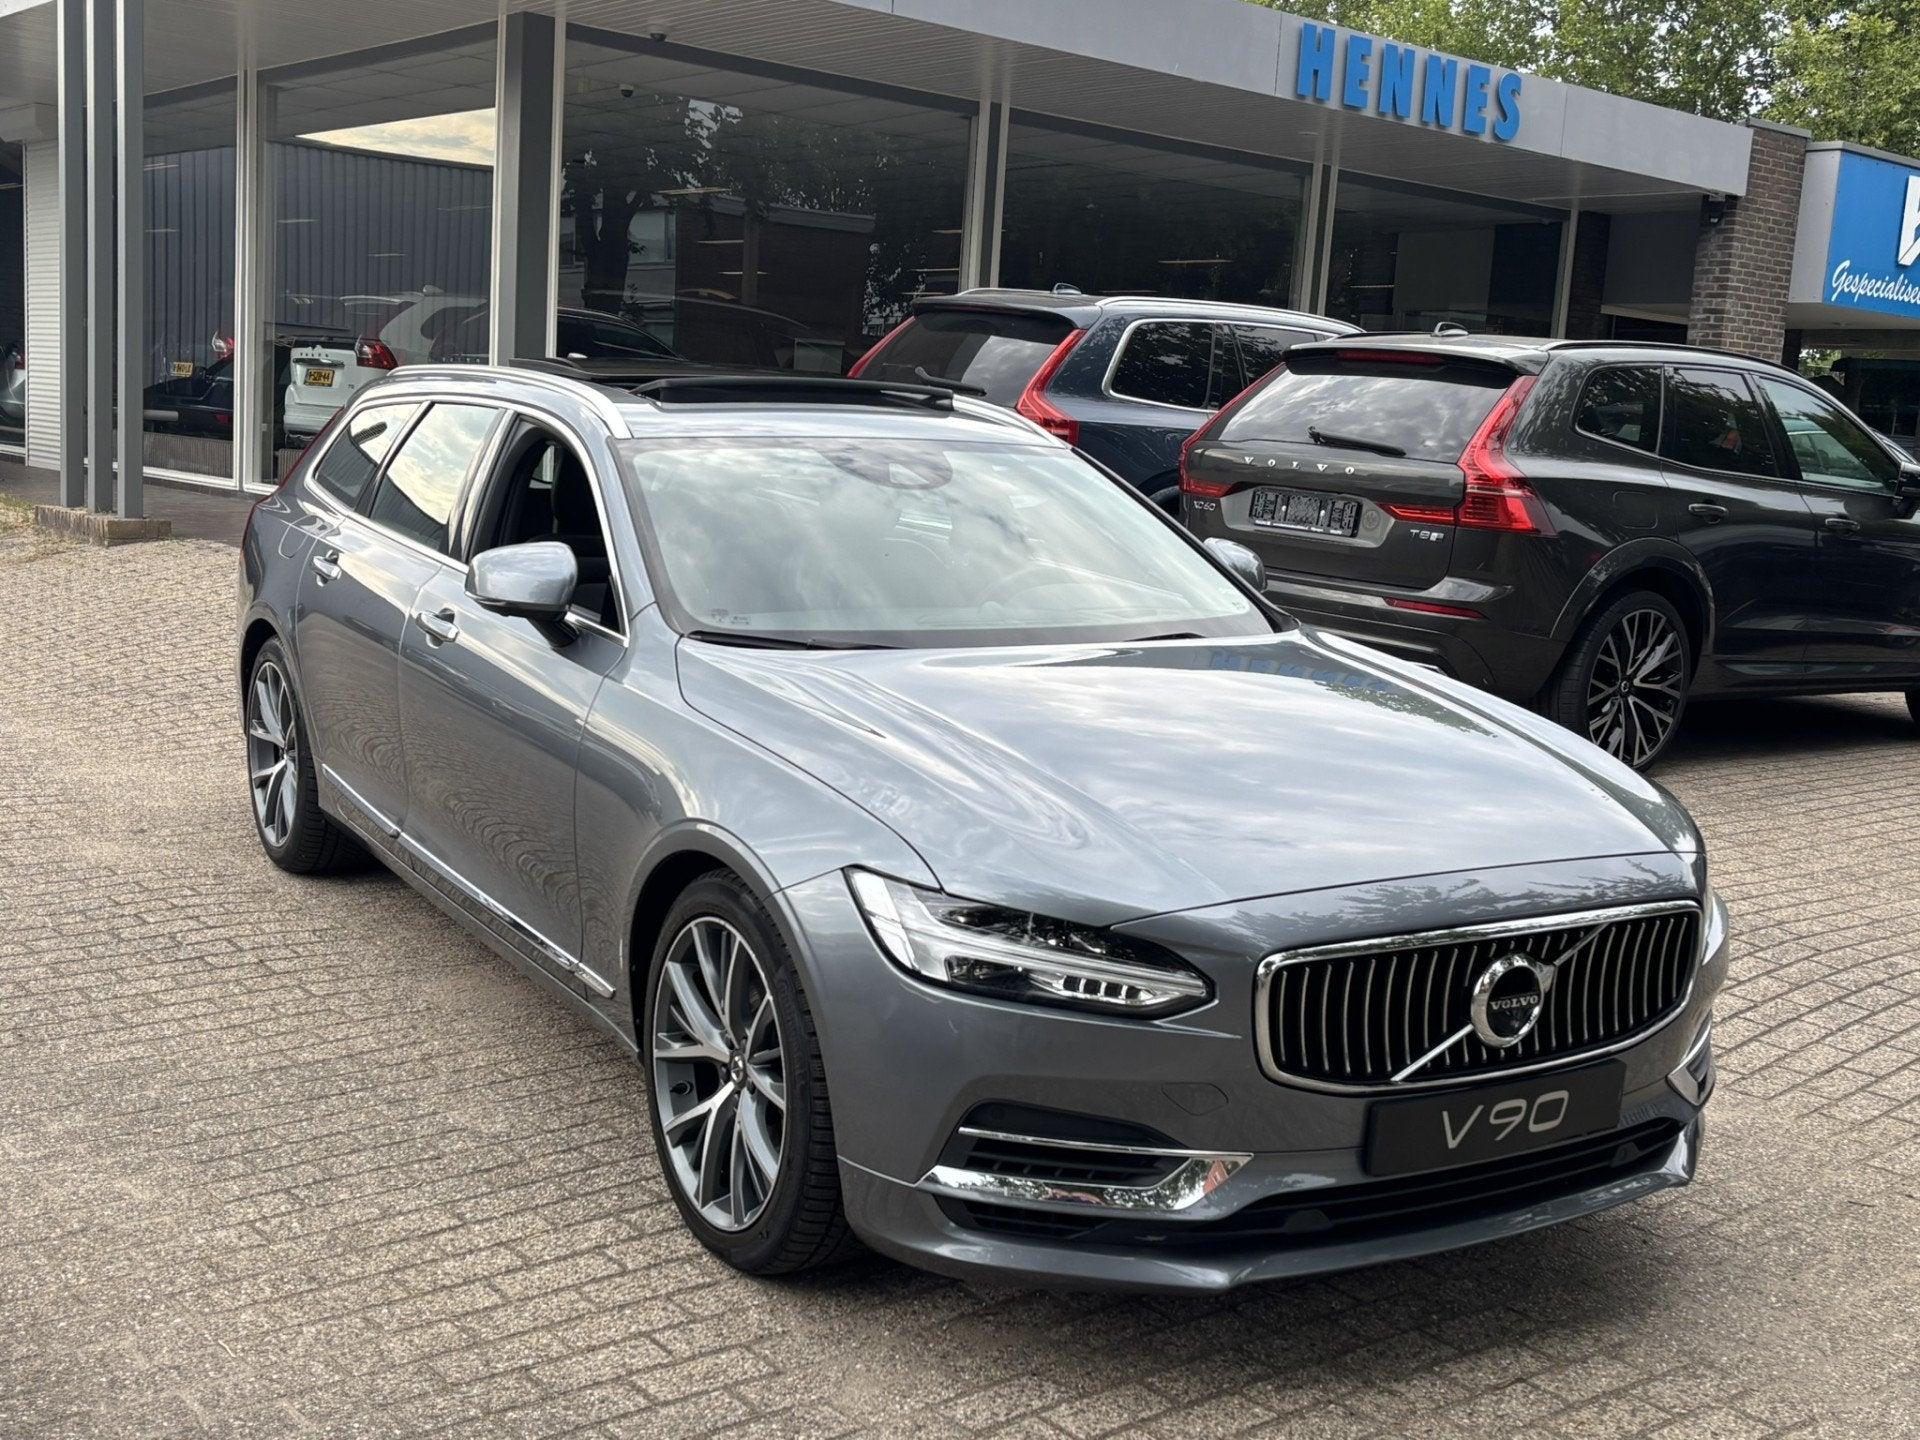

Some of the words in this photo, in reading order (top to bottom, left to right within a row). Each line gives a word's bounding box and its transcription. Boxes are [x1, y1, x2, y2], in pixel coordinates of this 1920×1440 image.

[1297, 22, 1522, 142] HENNES
[1244, 456, 1355, 475] VOLVO
[1489, 995, 1539, 1010] VOLVO
[1442, 1090, 1569, 1149] V90
